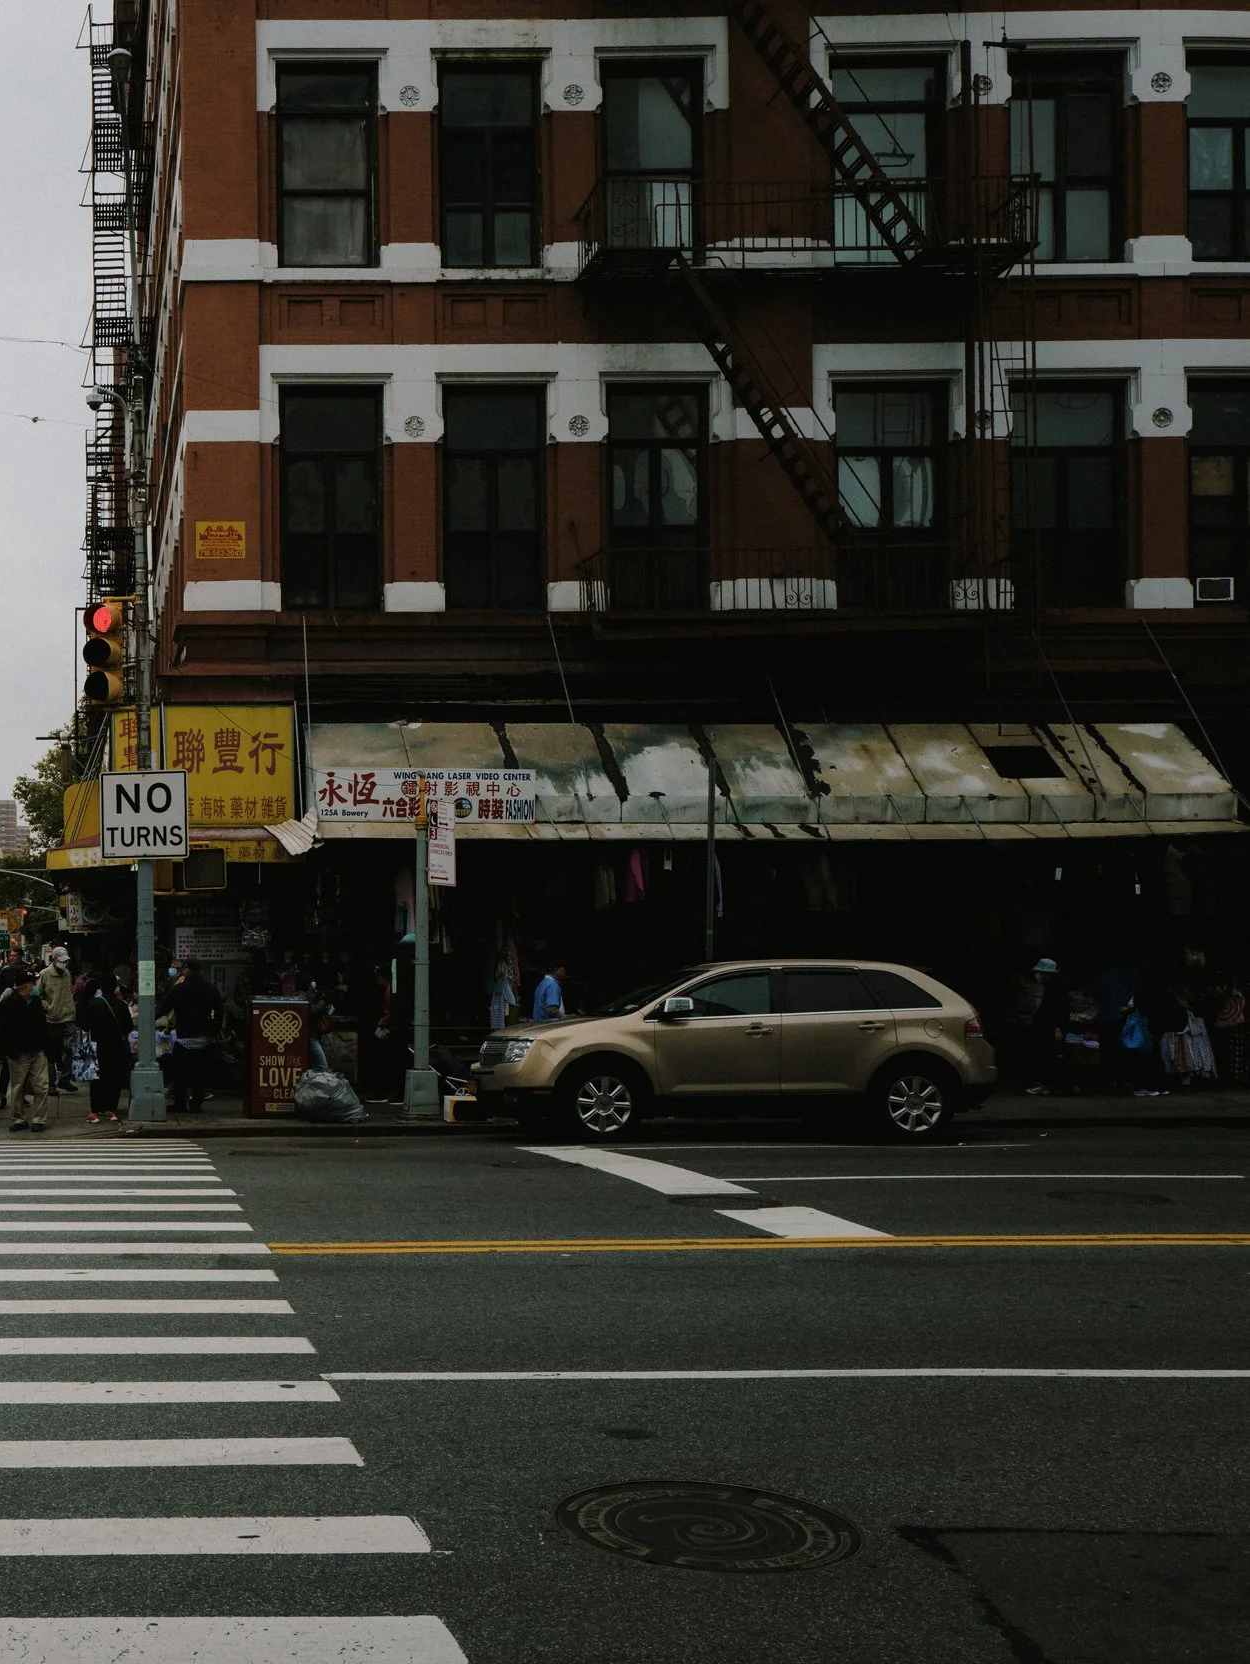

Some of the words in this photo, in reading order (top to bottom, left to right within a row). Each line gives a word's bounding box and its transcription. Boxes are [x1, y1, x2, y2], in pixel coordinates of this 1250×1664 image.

[172, 727, 285, 776] 聯豐行
[393, 771, 417, 780] WING
[426, 772, 444, 780] ANG
[447, 772, 471, 780] LASER
[476, 772, 499, 781] VIDEO
[503, 772, 531, 781] CENTER
[116, 782, 172, 814] NO
[199, 795, 226, 820] 海味
[229, 796, 259, 820] 藥材
[261, 795, 288, 820] 雜貨
[382, 798, 421, 819] 六合彩
[321, 808, 339, 816] 125A
[342, 809, 369, 818] Bowery
[477, 798, 504, 820] 時裝
[505, 798, 534, 820] FASHION
[106, 825, 183, 848] TURNS
[430, 828, 436, 839] 3
[259, 1055, 285, 1066] SHOW
[259, 1067, 302, 1087] LOVE
[273, 1088, 295, 1099] CLEA
